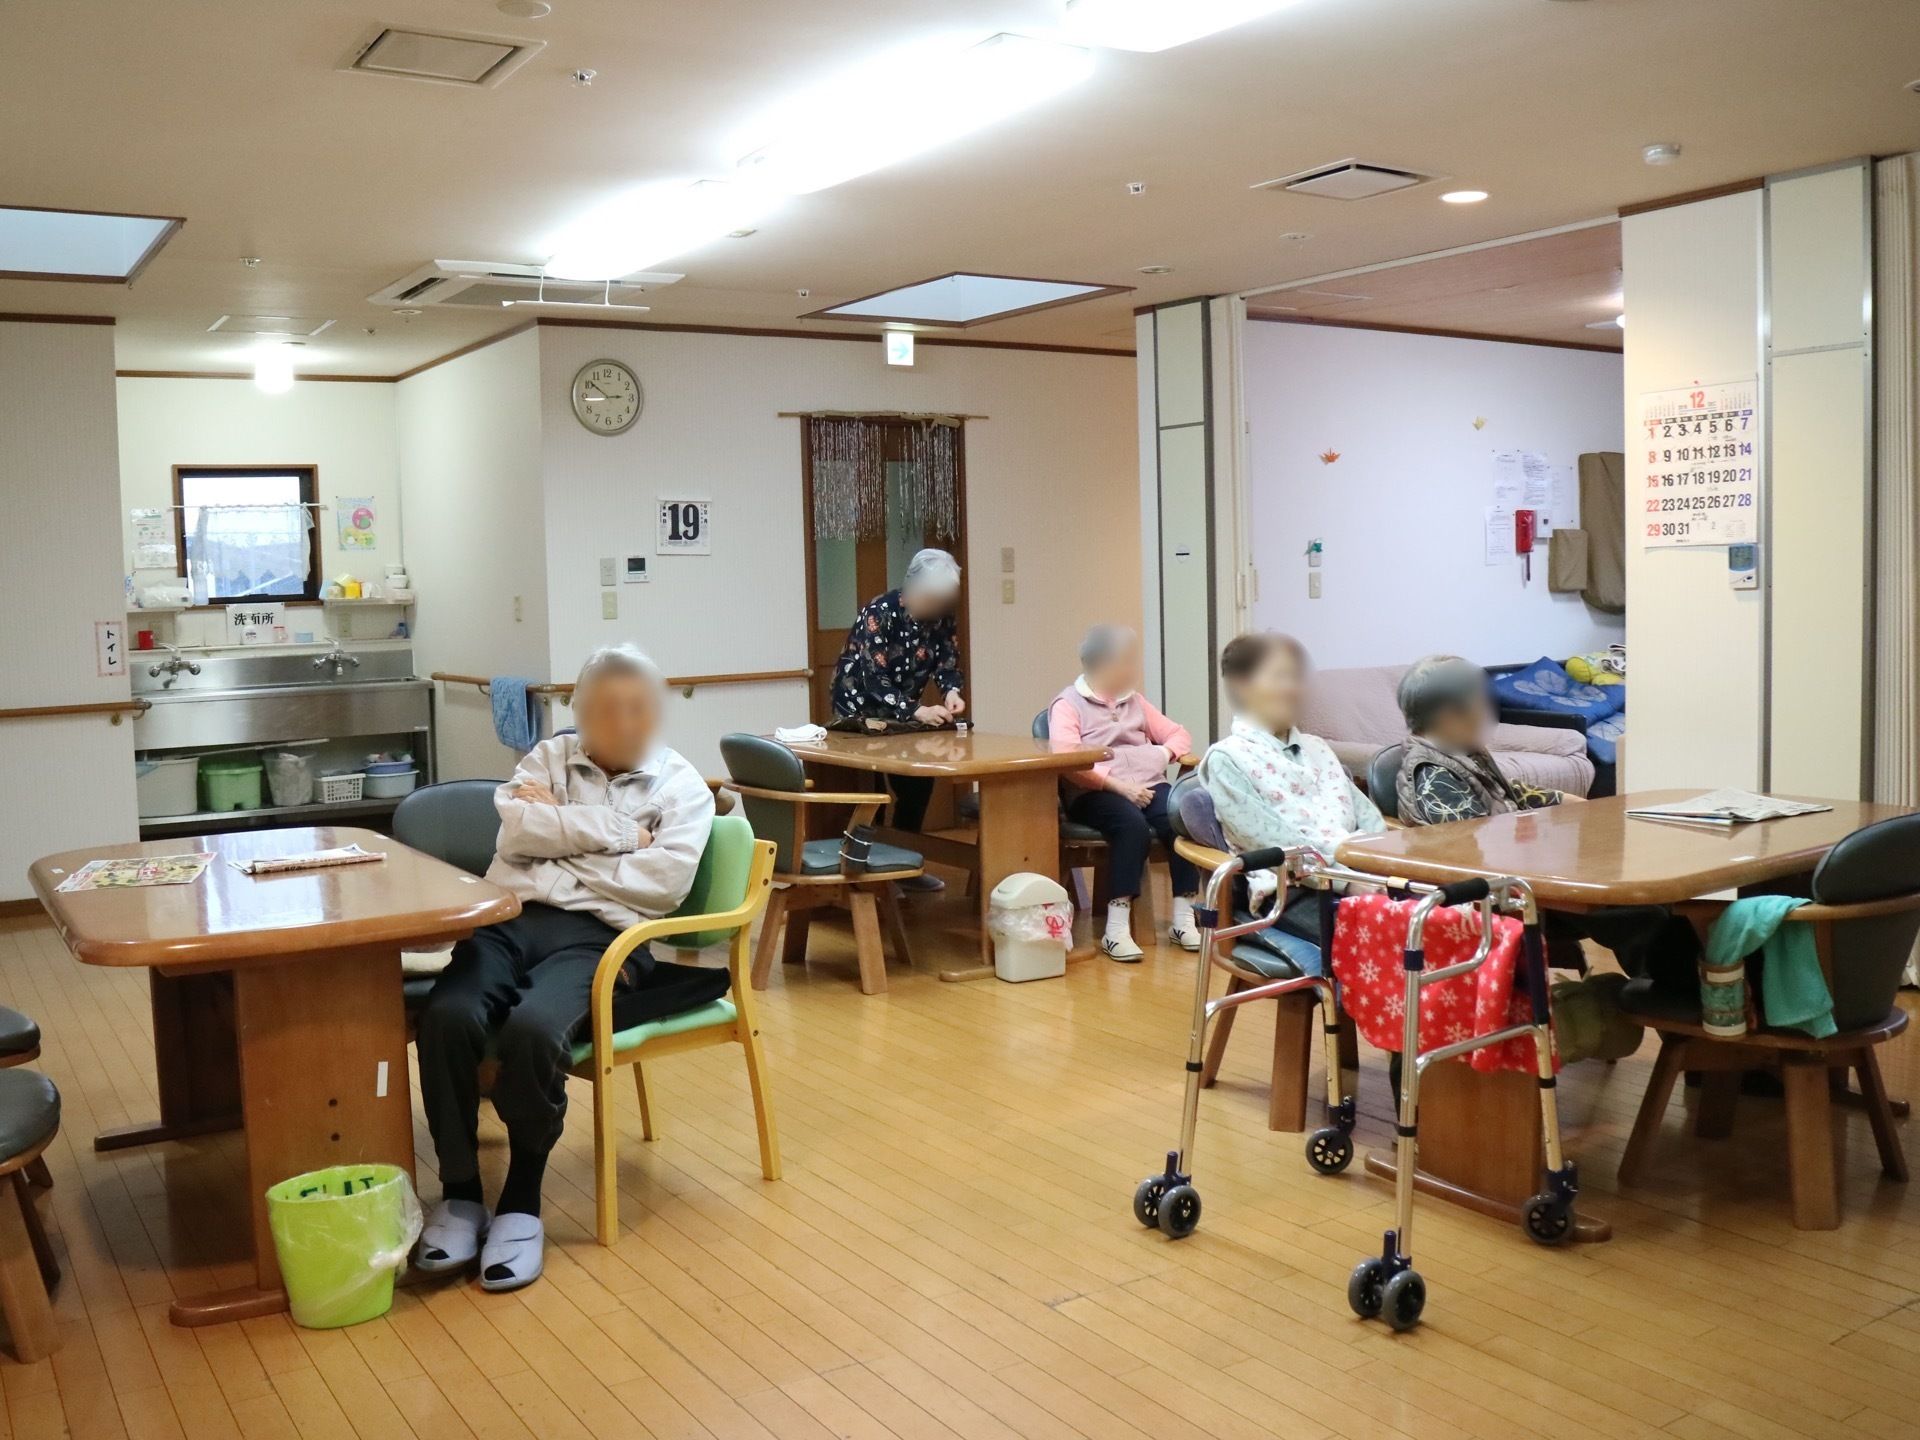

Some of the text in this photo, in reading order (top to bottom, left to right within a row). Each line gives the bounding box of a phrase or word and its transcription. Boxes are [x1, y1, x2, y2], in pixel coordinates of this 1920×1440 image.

[592, 372, 600, 380] 11
[603, 368, 612, 378] 12
[624, 381, 630, 390] 2
[628, 393, 634, 402] 3
[1690, 391, 1704, 408] 12
[586, 406, 592, 414] 8
[625, 406, 630, 414] 4
[595, 414, 600, 423] 7
[605, 417, 612, 425] 6
[617, 414, 622, 423] 5
[1648, 427, 1655, 439] 1
[1663, 425, 1672, 437] 2
[1678, 424, 1687, 436] 3
[1694, 422, 1702, 434] 4
[1709, 420, 1717, 433] 5
[1725, 419, 1733, 431] 6
[1740, 417, 1748, 430] 7
[1648, 442, 1752, 464] 8 9 10 11 12 13 14
[1647, 468, 1752, 488] 15 16 17 18 19 20 21
[1646, 493, 1752, 512] 22 23 24 25 26 27 28
[668, 504, 699, 540] 19
[1647, 524, 1660, 536] 29
[1662, 523, 1675, 536] 30
[1677, 522, 1690, 535] 31
[107, 630, 117, 665] トイレ
